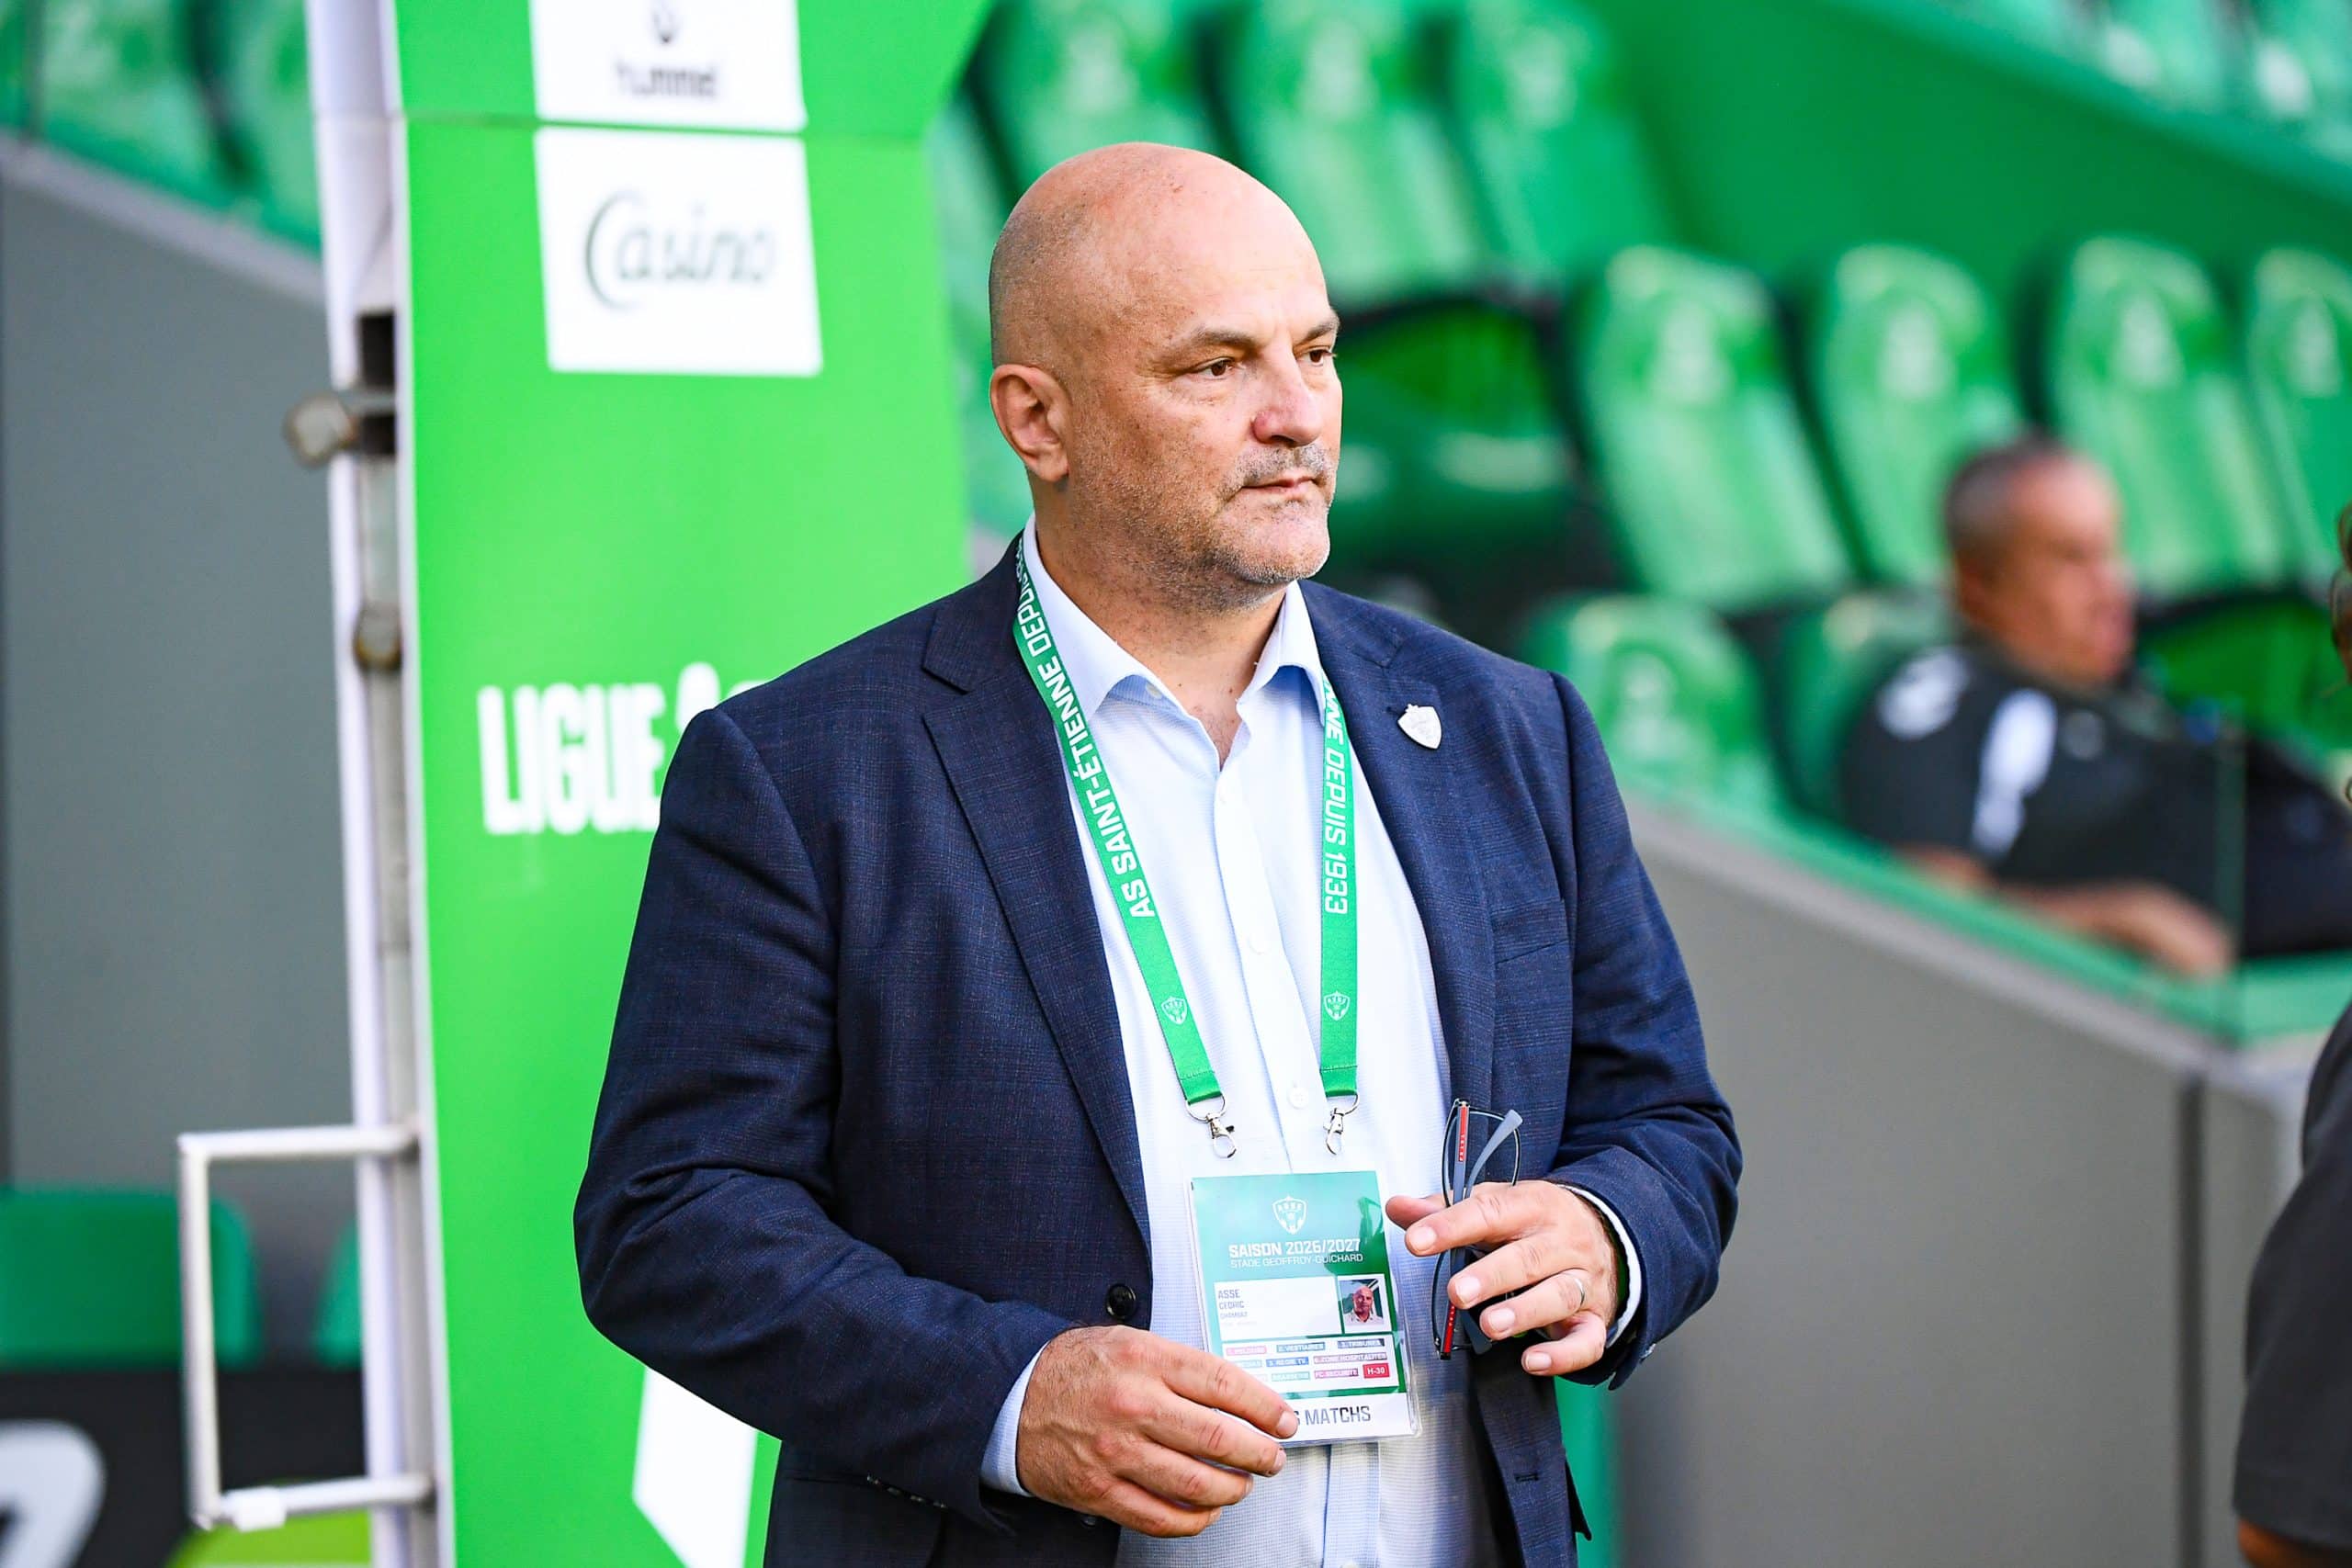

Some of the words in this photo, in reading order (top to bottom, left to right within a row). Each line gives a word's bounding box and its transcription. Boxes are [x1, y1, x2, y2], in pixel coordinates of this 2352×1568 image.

[583, 190, 775, 311] Casino
[476, 682, 667, 836] LIGUE
[1036, 655, 1137, 875] SAINT-ÉTIENNE
[1323, 746, 1348, 846] DEPUIS
[1121, 879, 1155, 919] AS
[1323, 853, 1348, 915] 1933
[1228, 1242, 1283, 1258] SAISON
[1229, 1258, 1261, 1269] STADE
[1305, 1405, 1371, 1425] MATCHS
